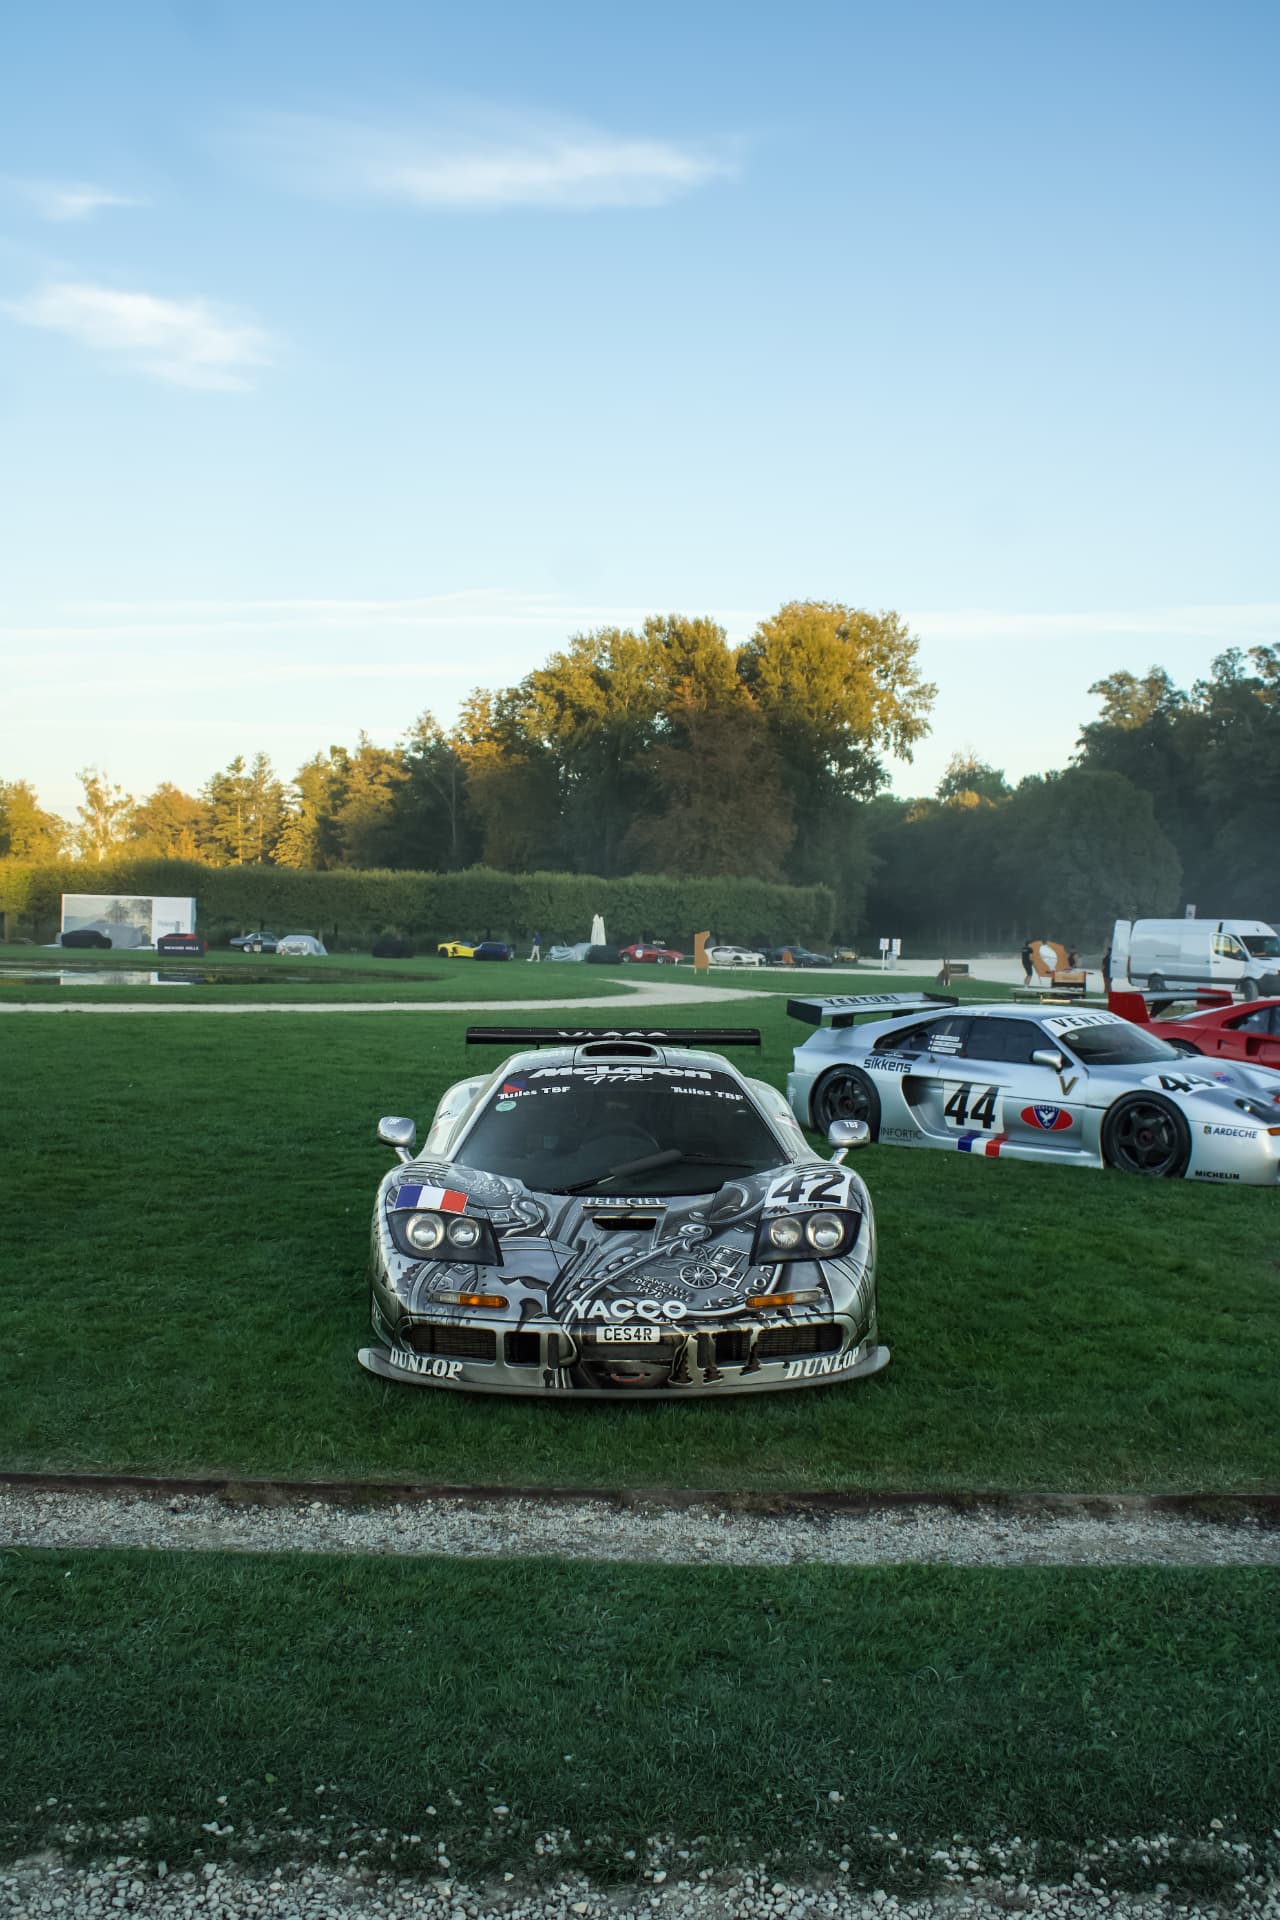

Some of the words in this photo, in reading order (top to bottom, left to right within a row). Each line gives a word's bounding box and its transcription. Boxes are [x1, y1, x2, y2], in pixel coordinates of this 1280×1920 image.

[824, 995, 899, 1006] VENTURI
[529, 1065, 712, 1080] McLaren
[863, 1057, 912, 1073] sikkens
[584, 1074, 653, 1085] GTR
[498, 1088, 537, 1100] Tuiles
[542, 1085, 571, 1095] TBF
[670, 1086, 712, 1097] Tuiles
[714, 1091, 744, 1101] TBF
[944, 1082, 999, 1129] 44
[844, 1121, 859, 1129] TBF
[1195, 1170, 1240, 1180] MICHELIN
[771, 1171, 845, 1204] 42
[586, 1197, 666, 1206] TELECIEL
[571, 1300, 688, 1320] YACCO
[603, 1327, 653, 1341] CES4R
[389, 1346, 463, 1381] DUNLOP
[784, 1346, 860, 1379] DUNLOP
